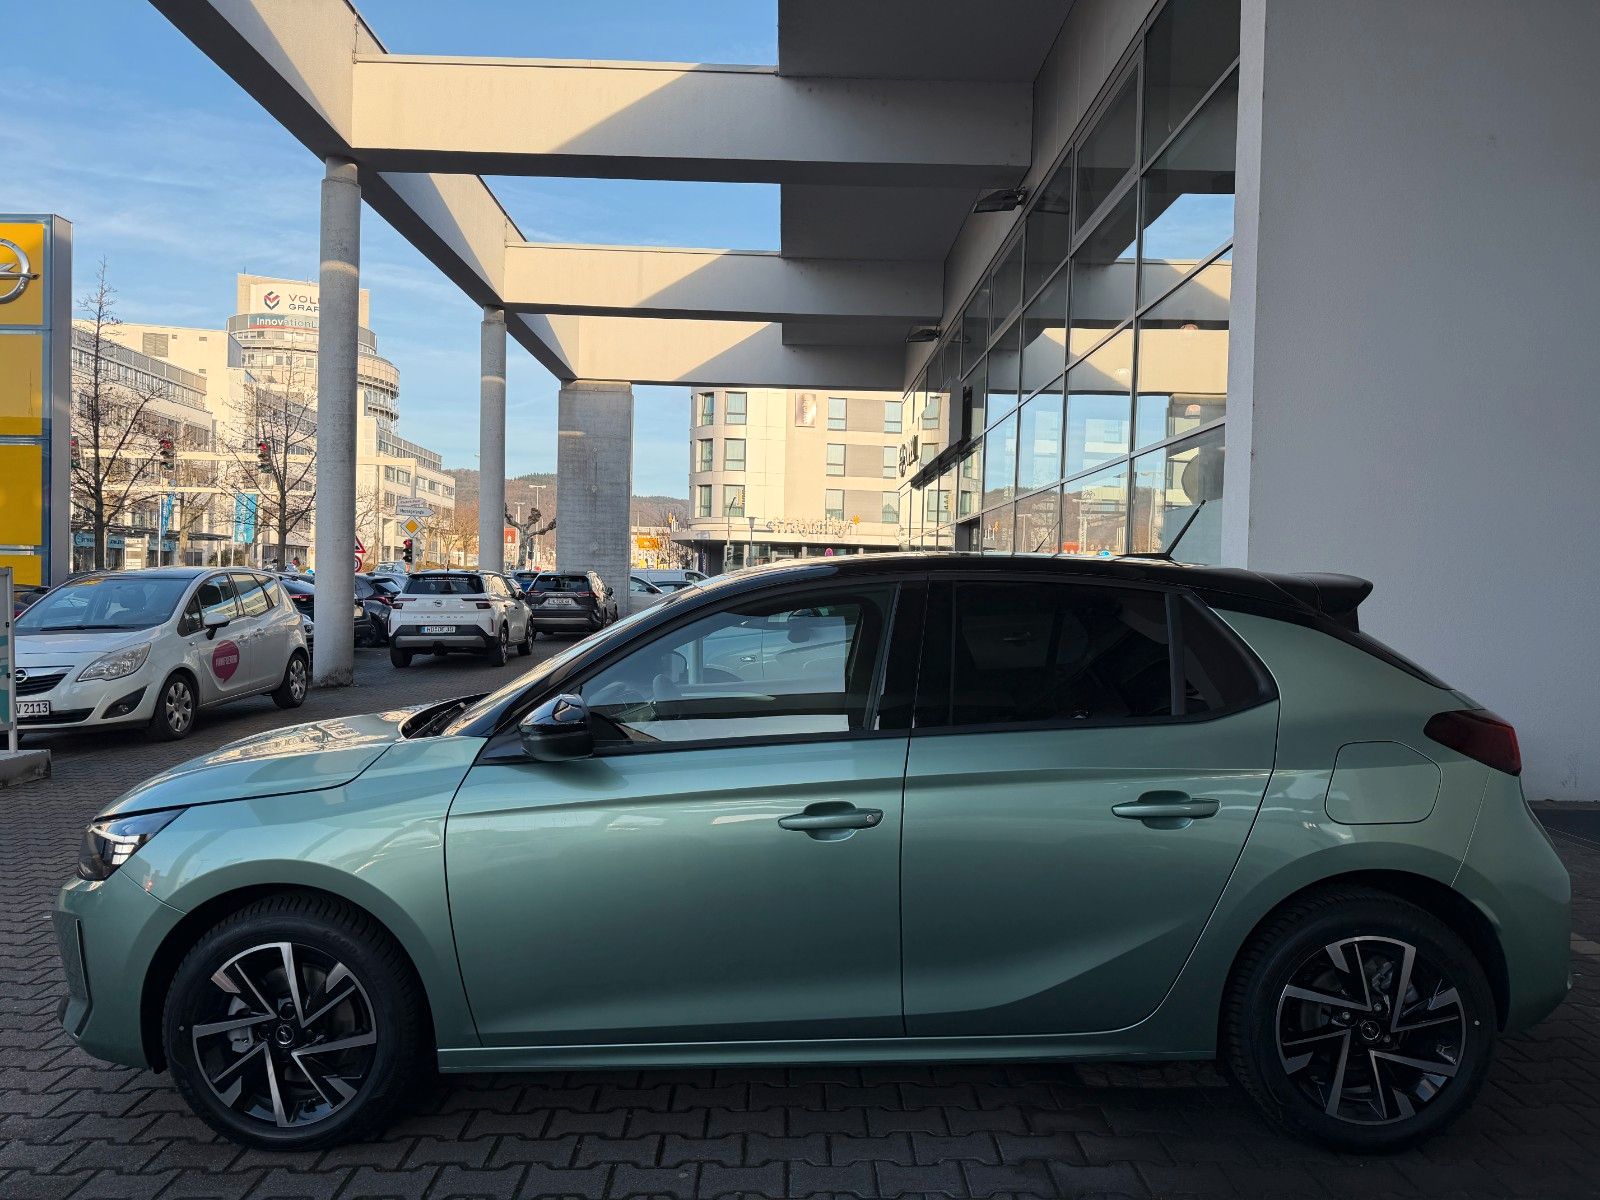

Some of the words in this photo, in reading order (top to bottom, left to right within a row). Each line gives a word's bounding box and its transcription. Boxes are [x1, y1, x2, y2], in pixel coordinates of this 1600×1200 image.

[288, 294, 320, 304] VOL
[256, 317, 320, 329] InnovationL
[23, 702, 48, 714] 2113
